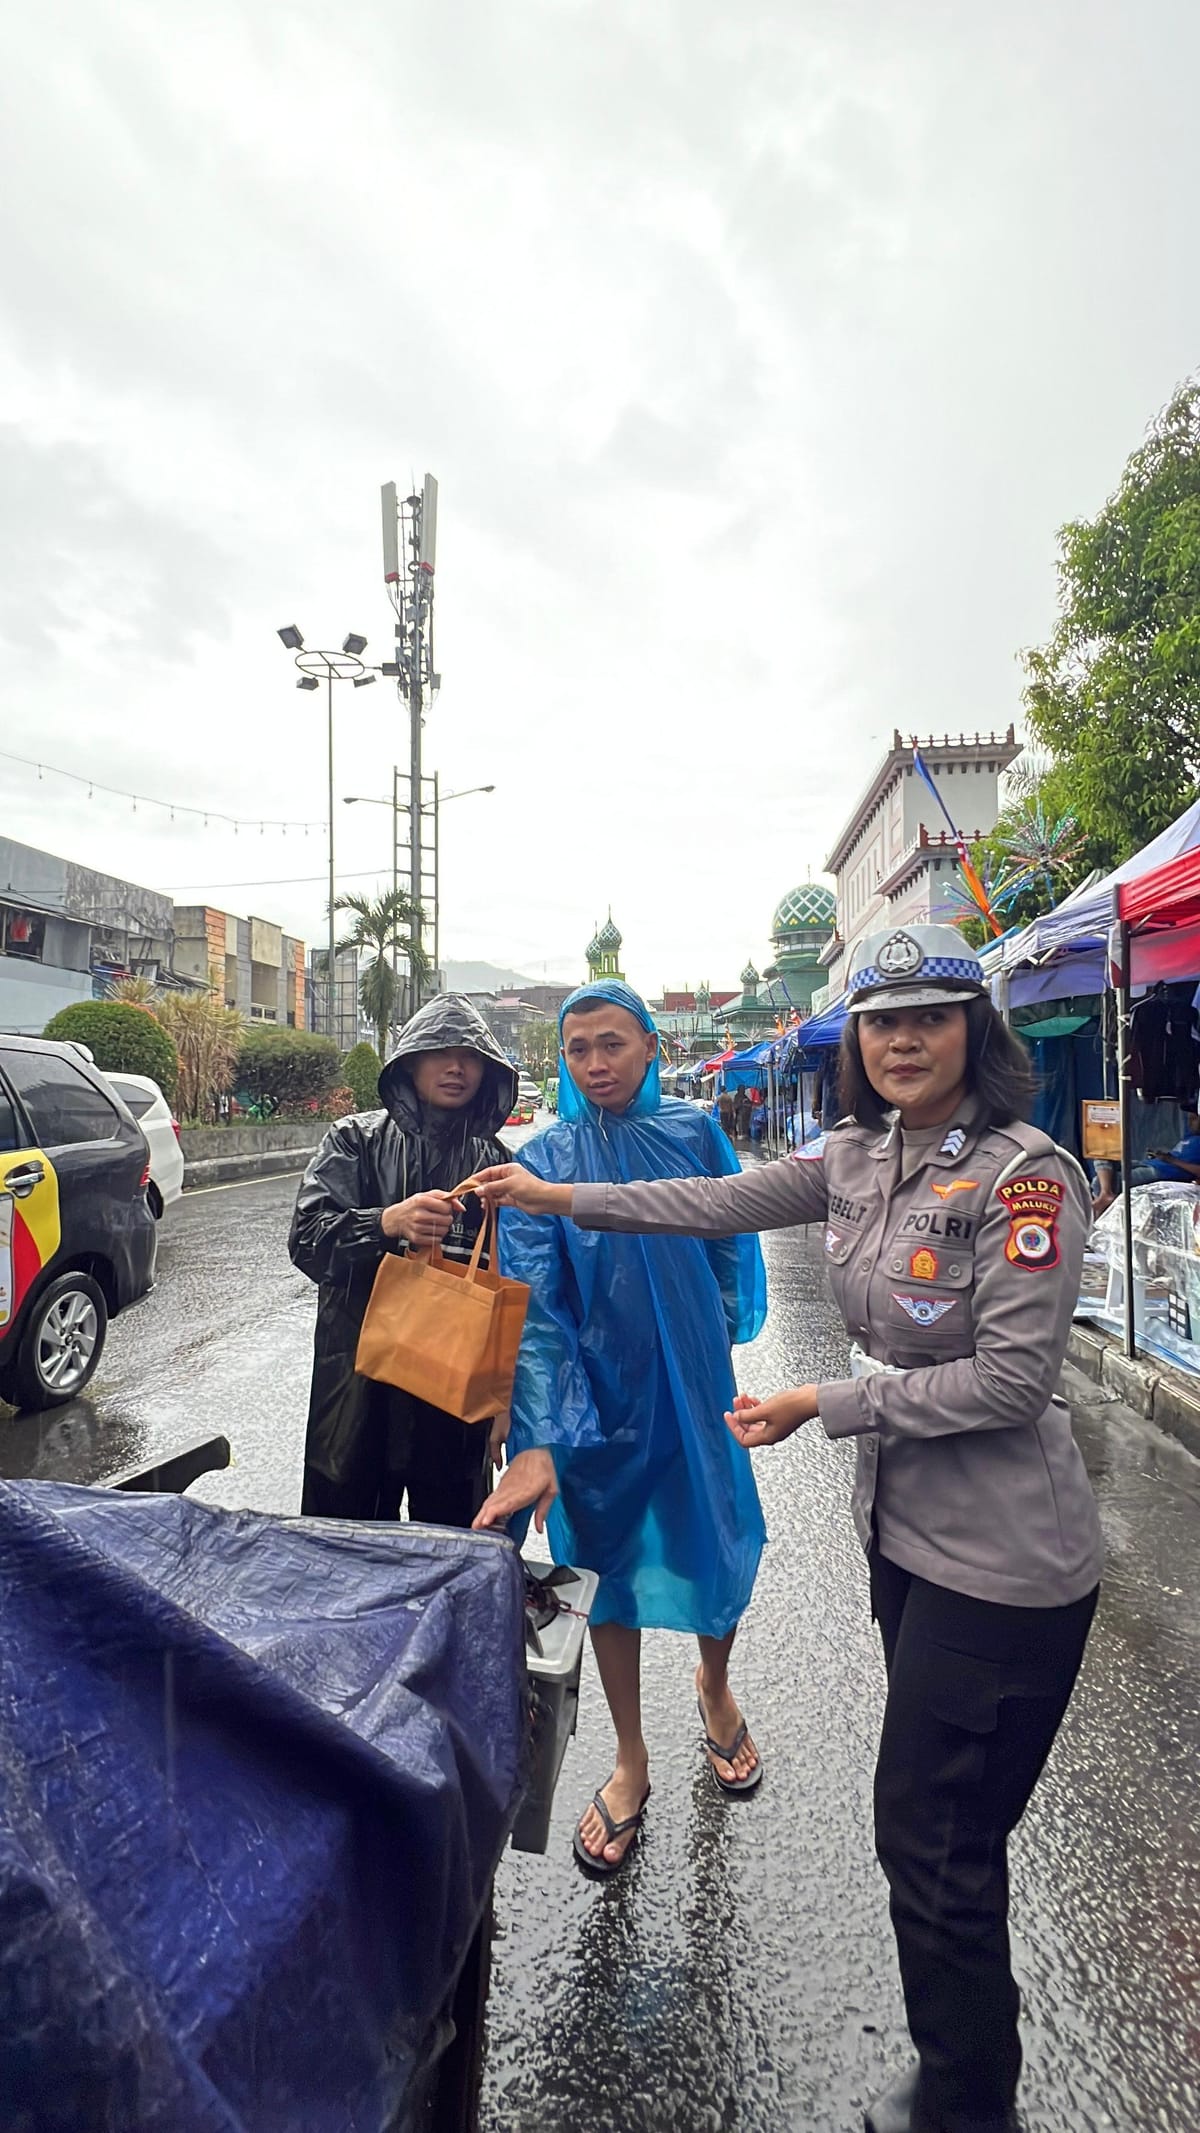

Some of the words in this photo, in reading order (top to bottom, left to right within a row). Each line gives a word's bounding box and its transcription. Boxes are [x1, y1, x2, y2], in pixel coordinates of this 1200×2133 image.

[1001, 1180, 1060, 1199] POLDA
[1011, 1200, 1057, 1213] MALUKU
[903, 1213, 972, 1239] POLRI
